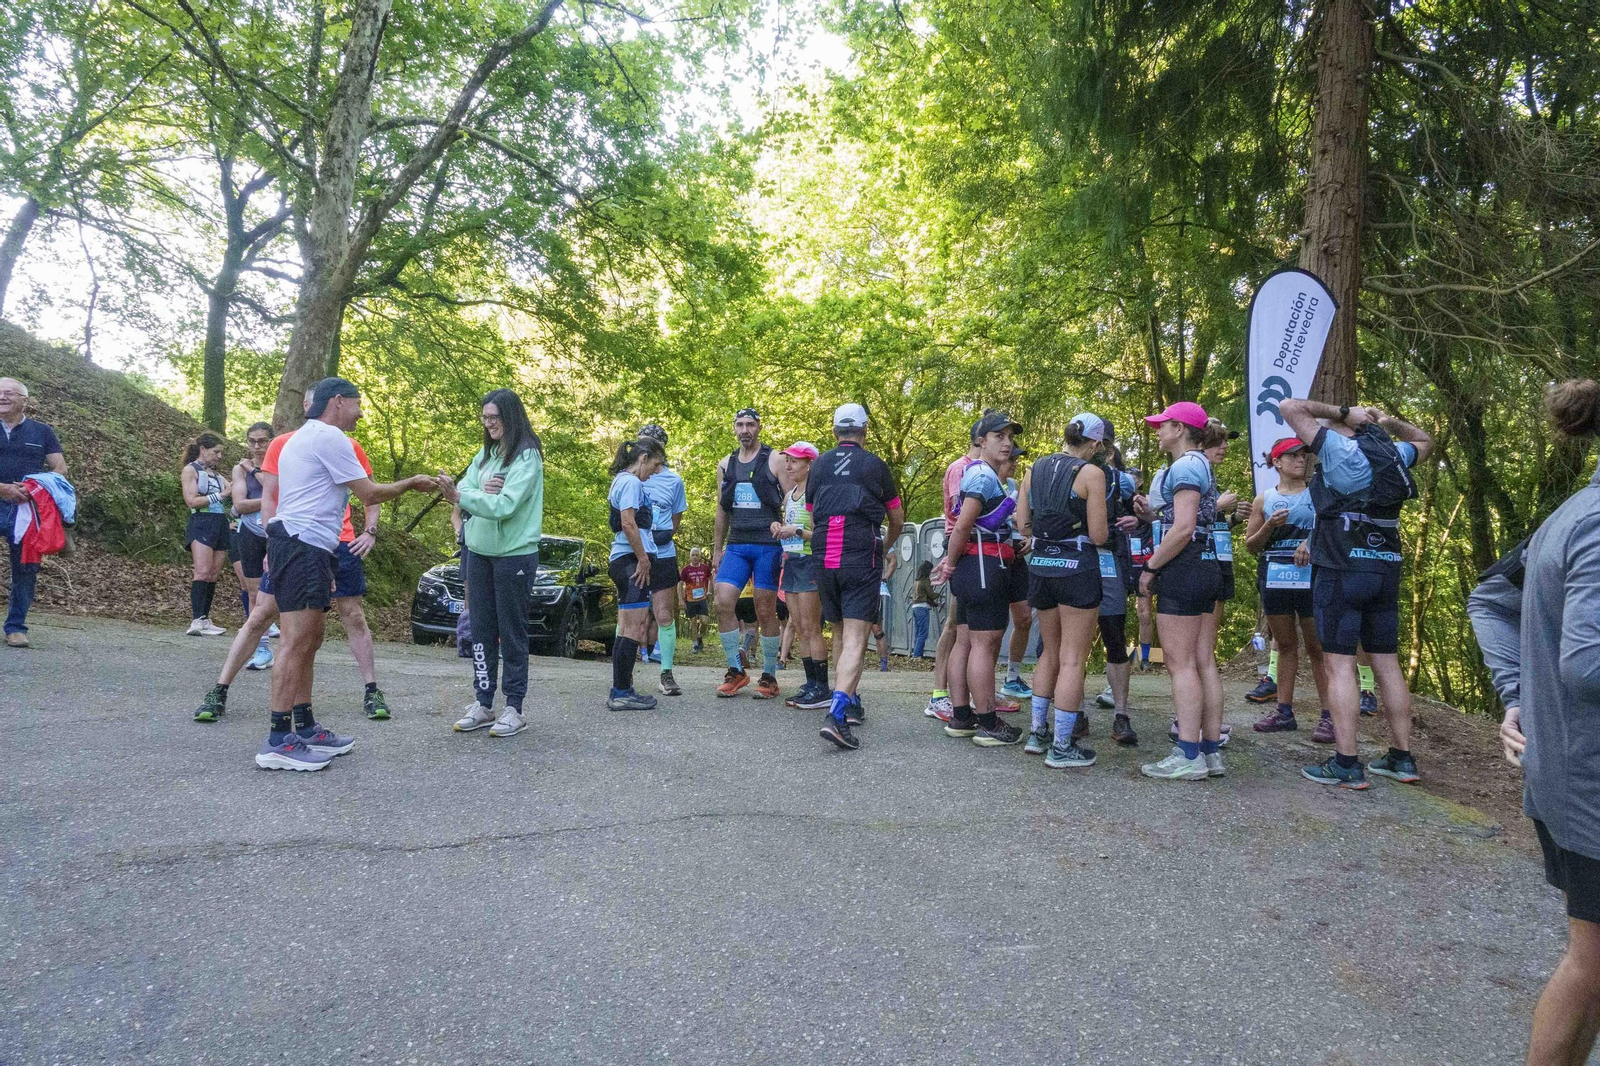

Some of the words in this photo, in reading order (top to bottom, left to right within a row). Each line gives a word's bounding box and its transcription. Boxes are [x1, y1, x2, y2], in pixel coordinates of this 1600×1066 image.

[1273, 292, 1307, 368] Deputación
[1285, 297, 1319, 374] Pontevedra
[737, 493, 752, 501] 268
[1277, 571, 1300, 580] 409
[473, 643, 489, 689] adidas
